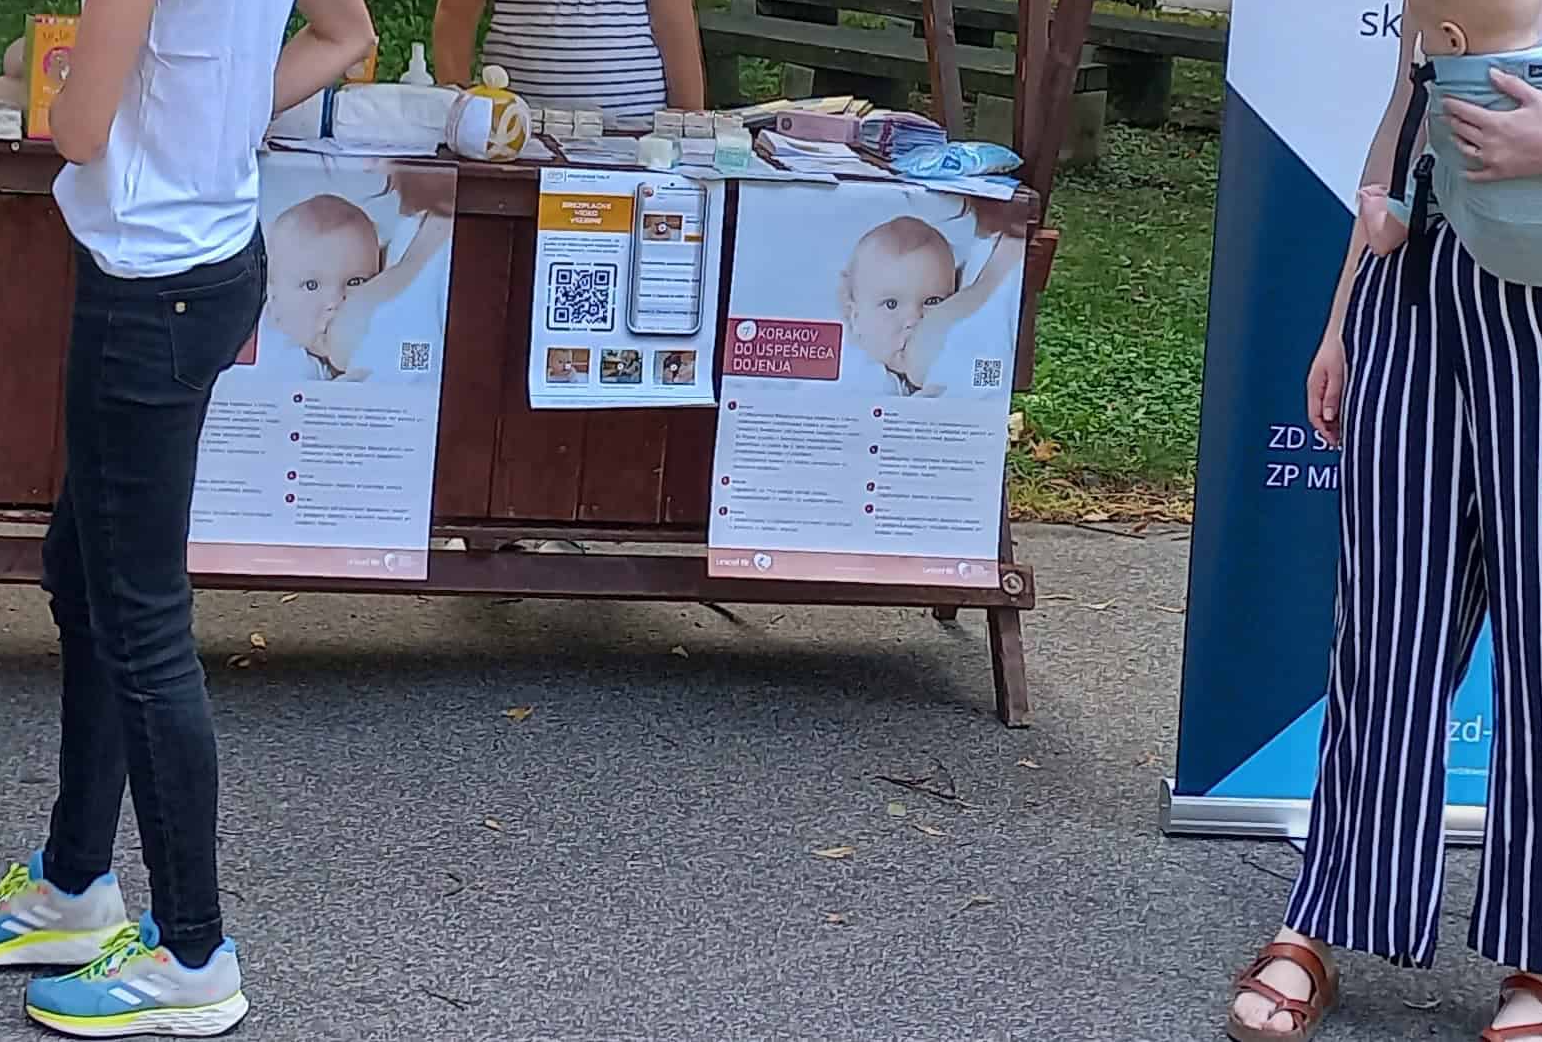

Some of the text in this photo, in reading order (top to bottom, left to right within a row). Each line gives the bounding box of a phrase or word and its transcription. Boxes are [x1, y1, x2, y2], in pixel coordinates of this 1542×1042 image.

[1360, 3, 1403, 38] sk
[758, 327, 819, 343] KORAKOV
[734, 342, 836, 359] DO USPEŠNEGA
[733, 358, 793, 374] DOJENJA
[1269, 426, 1306, 448] ZD
[1266, 464, 1339, 489] ZP Mi
[1450, 715, 1492, 743] zd-
